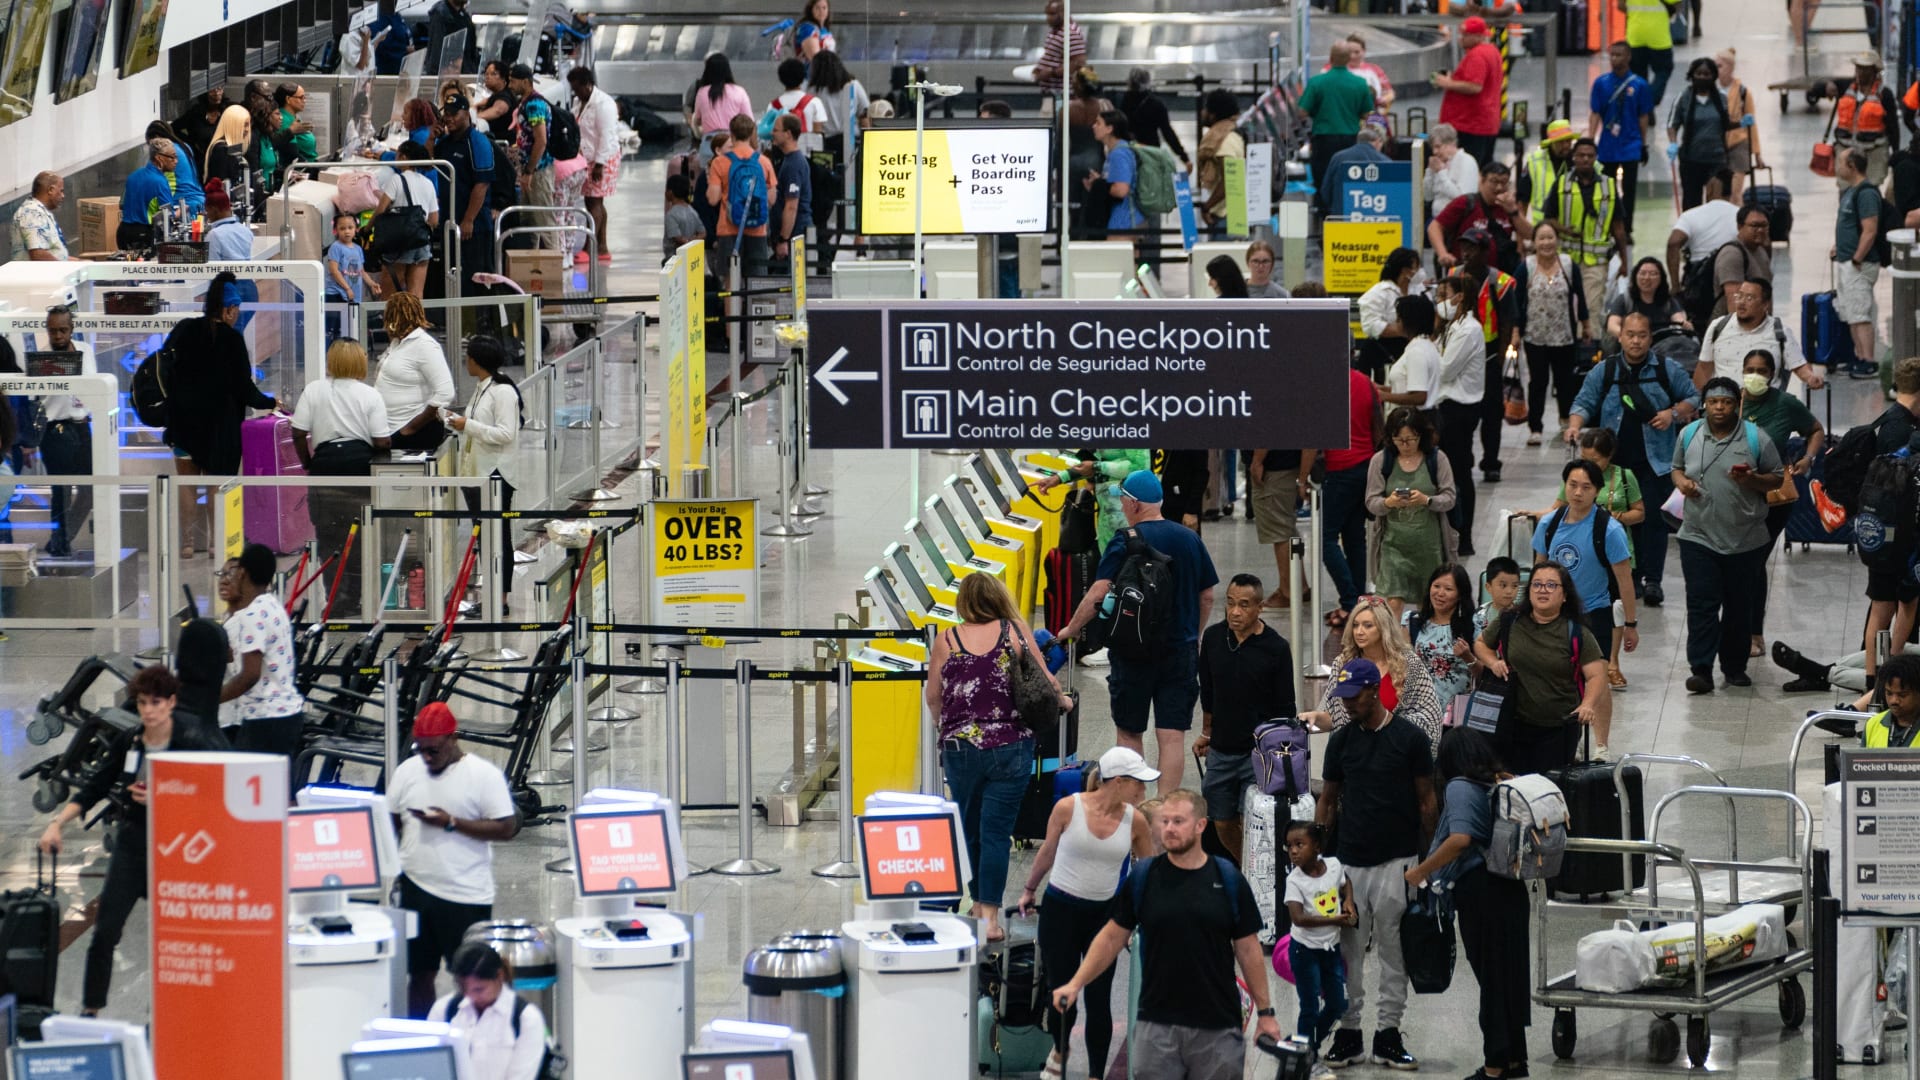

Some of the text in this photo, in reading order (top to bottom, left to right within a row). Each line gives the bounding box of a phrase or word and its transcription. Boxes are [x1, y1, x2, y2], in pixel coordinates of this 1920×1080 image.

[879, 154, 937, 168] Self-Tag
[971, 153, 1034, 165] Get Your
[879, 170, 911, 181] Your
[971, 168, 1036, 182] Boarding
[879, 185, 905, 198] Bag
[971, 184, 1003, 195] Pass
[1349, 190, 1387, 212] Tag
[1331, 242, 1379, 252] Measure
[1331, 254, 1360, 264] Your
[122, 266, 148, 274] PLACE
[150, 266, 166, 274] ONE
[169, 266, 189, 274] ITEM
[12, 320, 39, 328] PLACE
[85, 320, 98, 328] ON
[100, 320, 117, 328] THE
[119, 320, 140, 328] BELT
[142, 320, 154, 328] AT
[156, 320, 162, 328] A
[164, 320, 178, 328] TIM
[956, 322, 1271, 355] North Checkpoint
[957, 355, 1206, 375] Control de Seguridad Norte
[2, 382, 69, 391] BELT AT A TIME
[957, 389, 1252, 423] Main Checkpoint
[957, 423, 1150, 442] Control de Seguridad
[688, 506, 707, 514] Your
[710, 506, 727, 515] Bag
[664, 516, 742, 540] OVER
[664, 544, 743, 561] 40 LBS?
[1852, 763, 1886, 771] Checked
[245, 775, 261, 806] 1
[321, 824, 331, 840] 1
[616, 828, 624, 843] 1
[903, 831, 912, 847] 1
[878, 857, 945, 874] CHECK-IN
[158, 880, 234, 899] CHECK-IN
[1861, 892, 1879, 901] Your
[1882, 892, 1906, 901] safety
[158, 901, 273, 920] TAG YOUR BAG
[158, 940, 214, 955] CHECK-IN
[158, 956, 234, 972] ETIQUETE SU
[158, 971, 213, 986] EQUIPAJE
